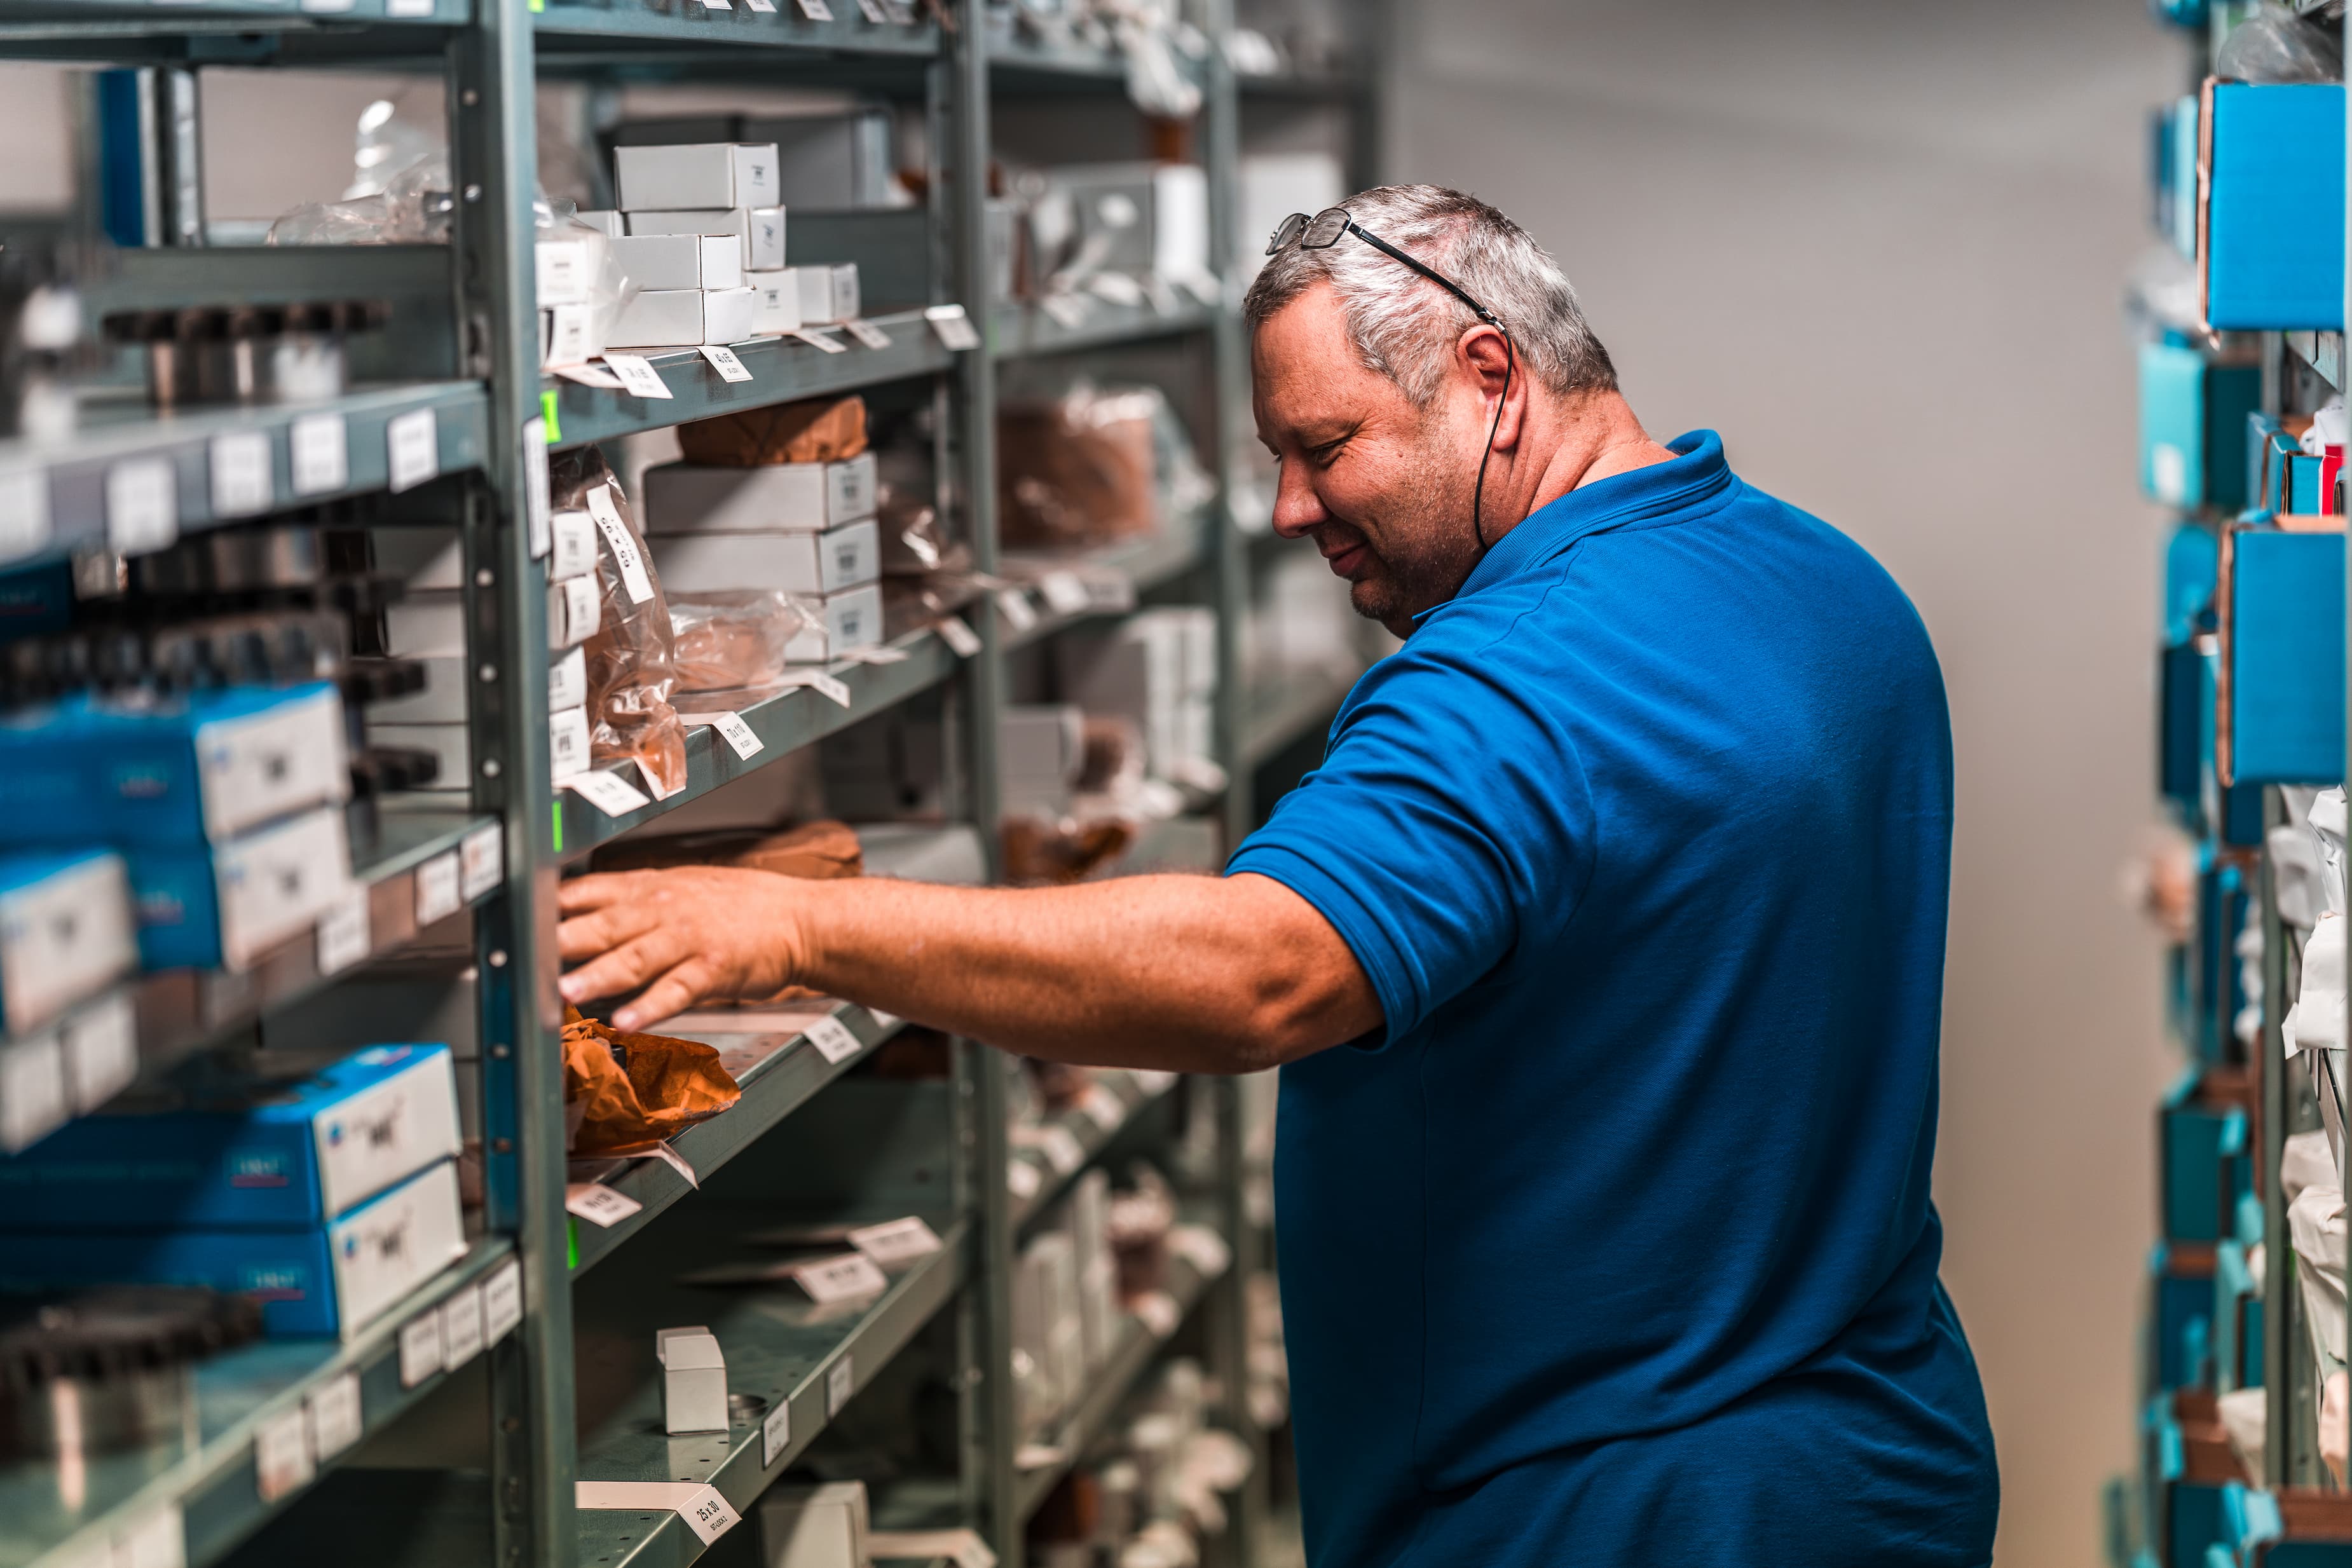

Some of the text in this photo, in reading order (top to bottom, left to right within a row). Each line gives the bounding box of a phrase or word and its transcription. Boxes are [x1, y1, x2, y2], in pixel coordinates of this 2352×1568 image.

[697, 1501, 720, 1522] 25 x 30
